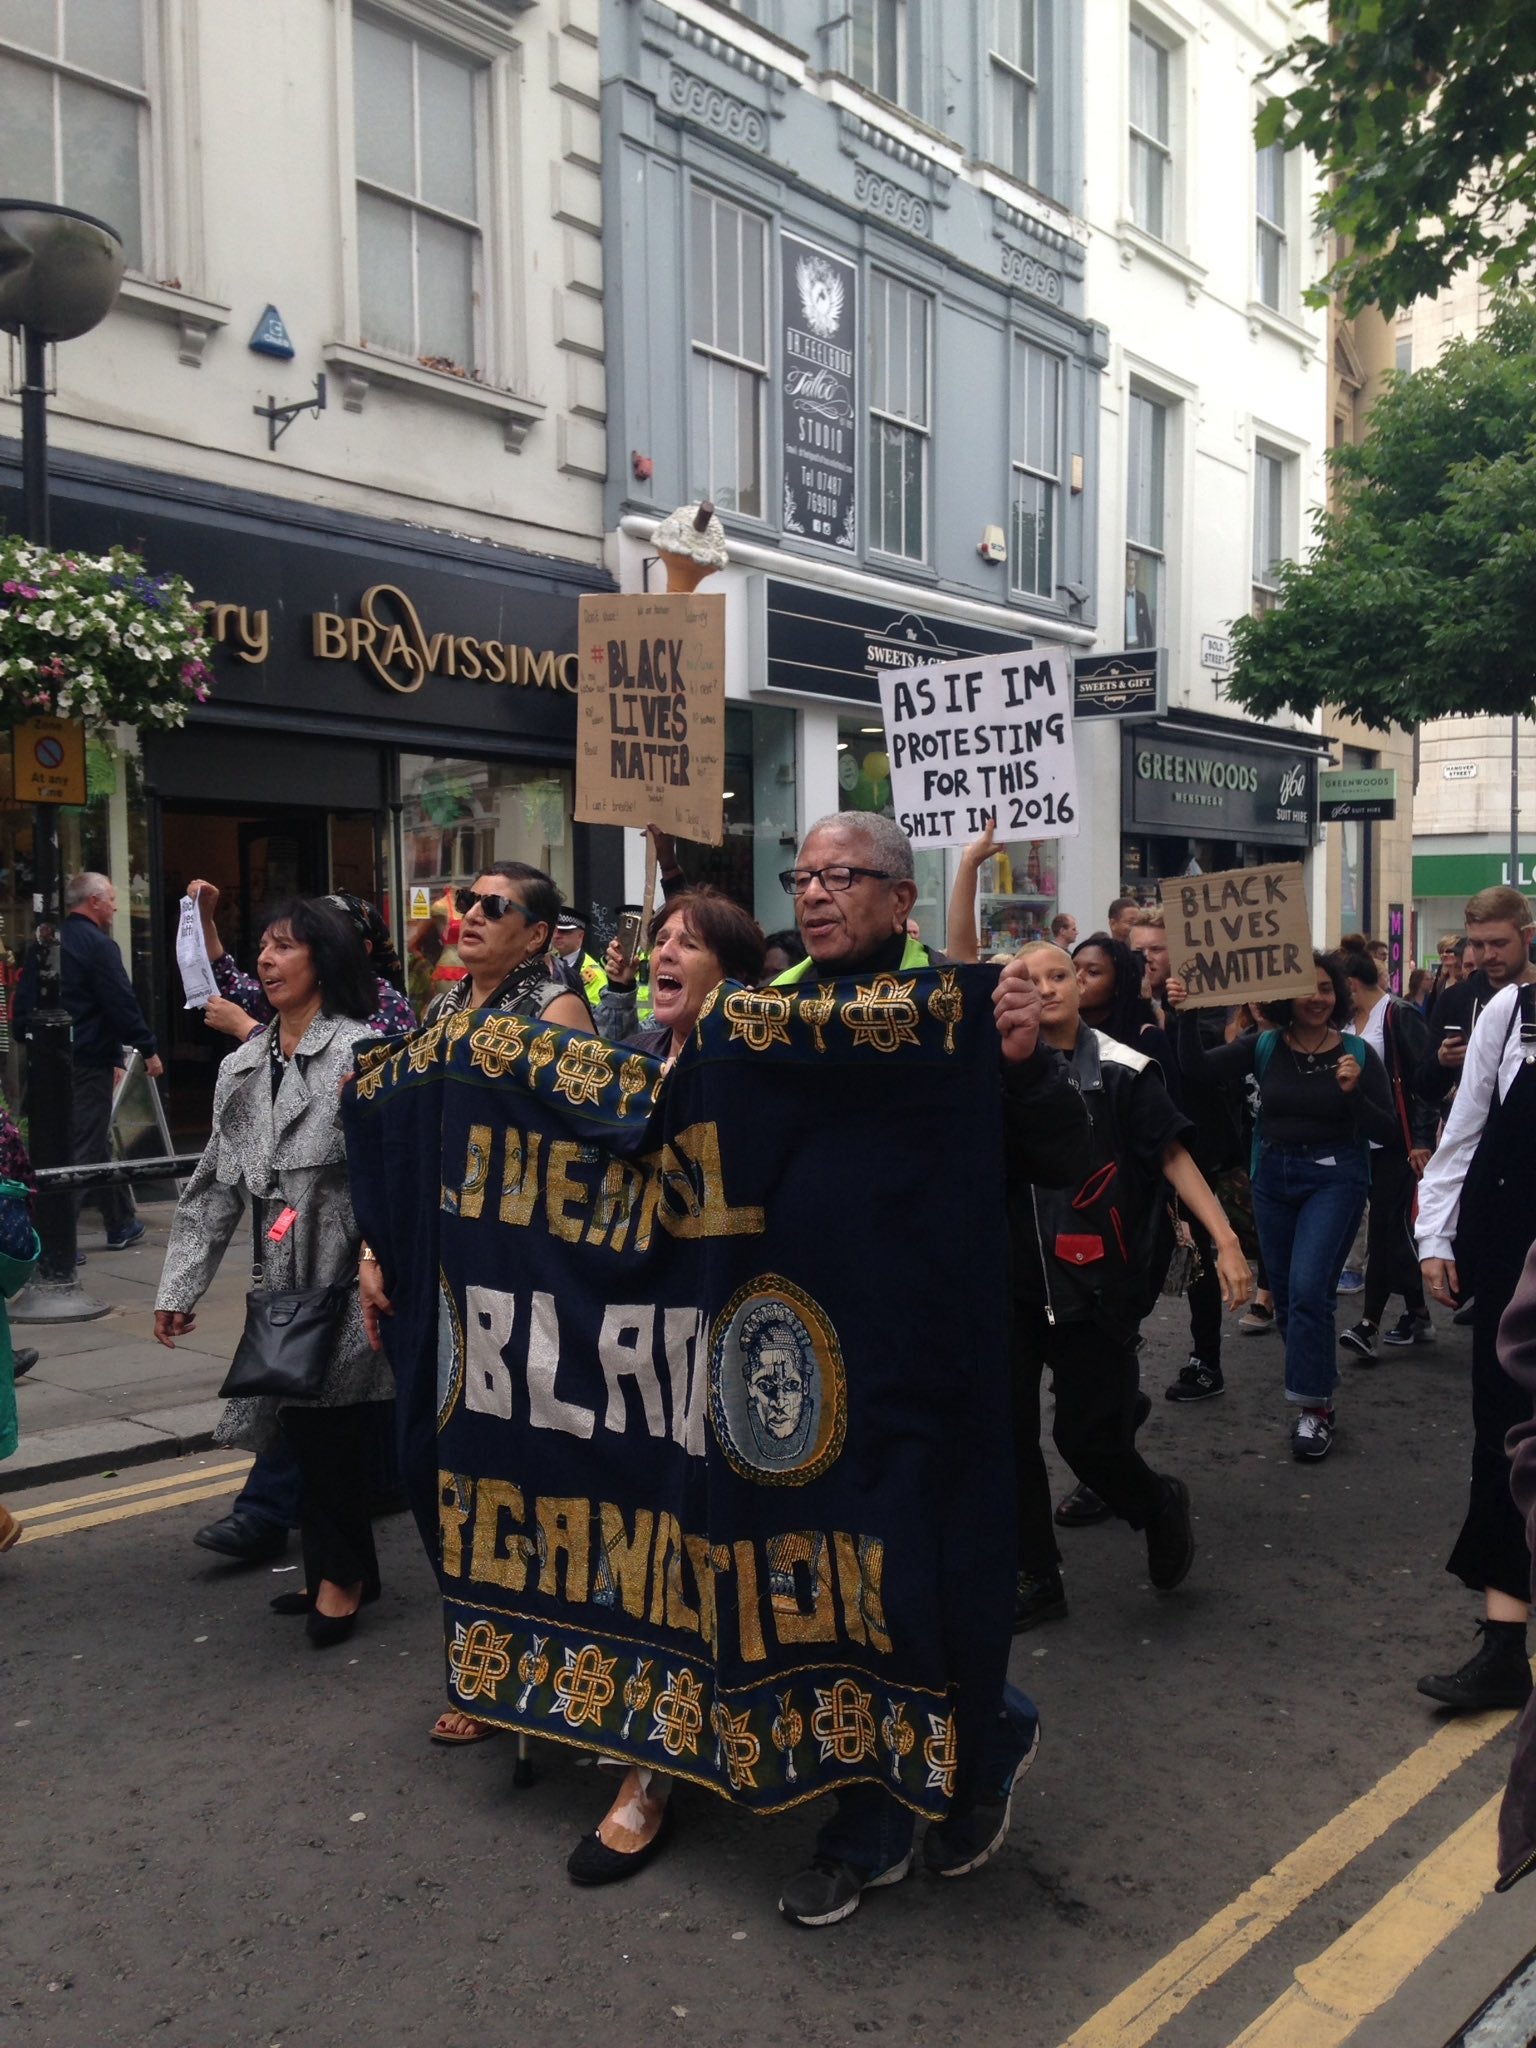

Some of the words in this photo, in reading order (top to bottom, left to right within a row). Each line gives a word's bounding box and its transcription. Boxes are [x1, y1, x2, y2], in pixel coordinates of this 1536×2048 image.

[799, 416, 843, 454] STUDIO
[200, 599, 269, 664] ry
[1208, 640, 1224, 652] BOLD
[867, 645, 915, 668] SWEETS
[1205, 652, 1226, 665] STREET
[894, 679, 935, 722] AS
[944, 671, 983, 713] IF
[1001, 660, 1055, 708] IM
[1080, 681, 1118, 692] SWEETS
[1119, 680, 1127, 689] &
[1128, 678, 1151, 688] GIFT
[609, 693, 688, 742] LIVES
[893, 713, 1065, 768] PROTESTING
[31, 772, 46, 784] At
[49, 775, 69, 787] any
[611, 739, 690, 786] MATTER
[924, 769, 970, 801] FOR
[977, 760, 1039, 798] THIS
[1138, 751, 1258, 793] GREENWOODS
[1175, 791, 1224, 807] MENSWEAR
[1325, 777, 1389, 789] GREENWOODS
[900, 810, 956, 838] SHIT
[966, 804, 997, 833] IN
[1009, 792, 1075, 828] 2016
[1276, 808, 1292, 821] SUIT
[1293, 810, 1308, 824] HIRE
[1181, 875, 1287, 918] BLACK
[1184, 910, 1280, 947] LIVES
[1196, 943, 1302, 993] MATTER
